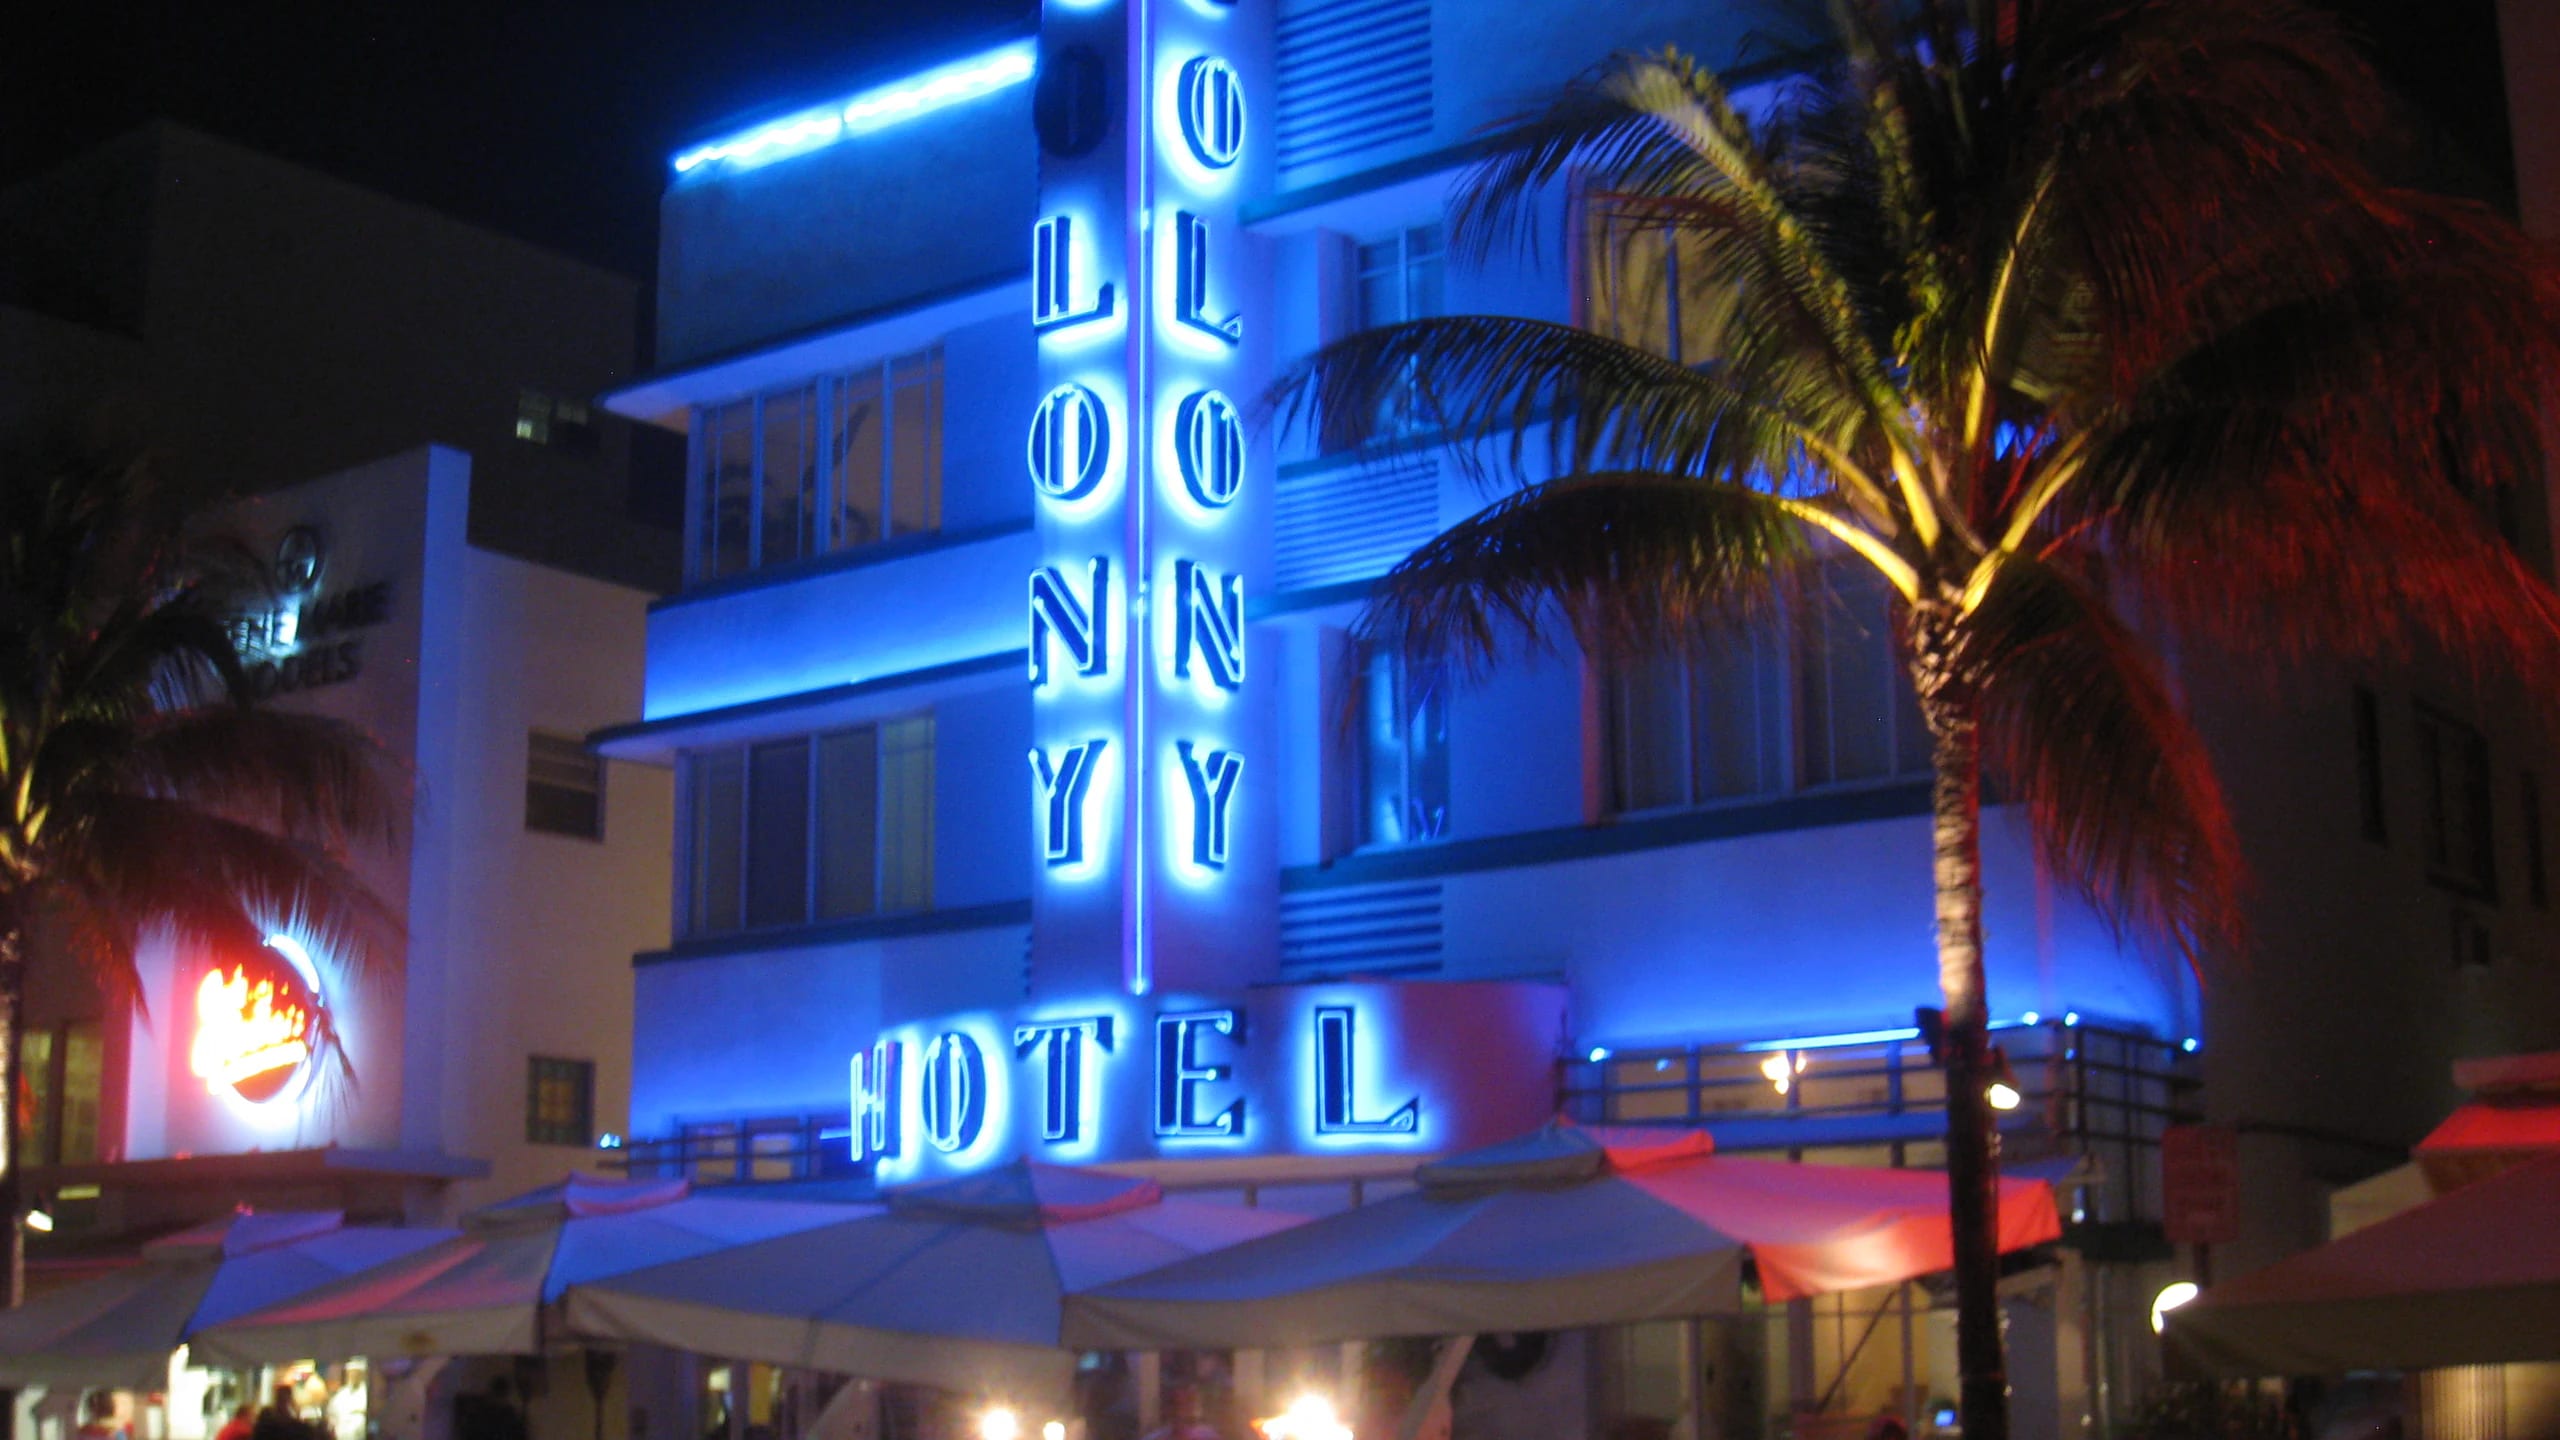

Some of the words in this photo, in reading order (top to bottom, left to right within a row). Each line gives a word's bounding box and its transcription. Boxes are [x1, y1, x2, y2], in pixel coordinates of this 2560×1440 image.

[1028, 0, 1114, 866] OLONY
[1174, 0, 1248, 869] OLONY
[849, 1005, 1421, 1163] HOTEL
